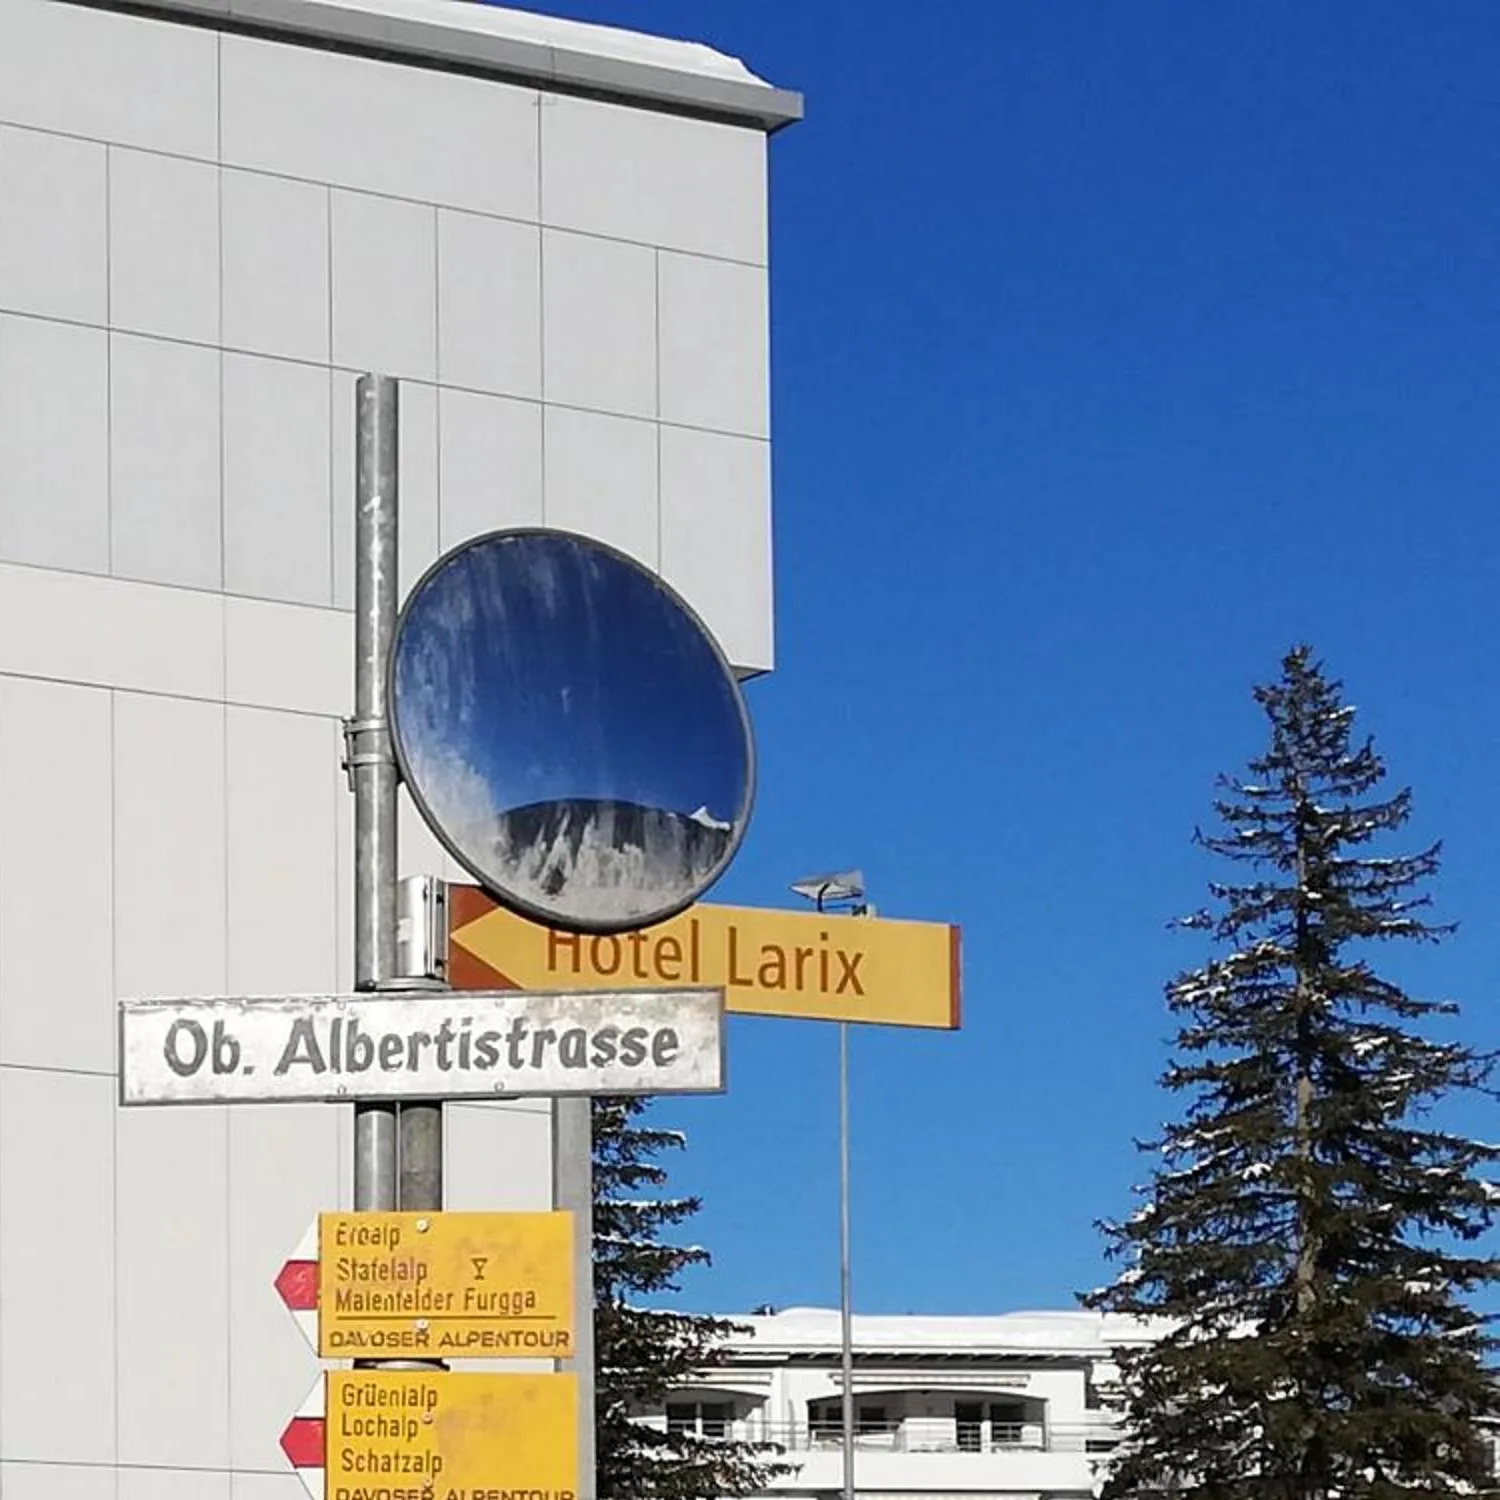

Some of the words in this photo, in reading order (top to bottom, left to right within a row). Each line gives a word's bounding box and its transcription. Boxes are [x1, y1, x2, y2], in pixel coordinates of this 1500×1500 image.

[547, 923, 702, 984] Hotel
[726, 924, 866, 996] Larix
[163, 1020, 254, 1077] Ob.
[274, 1017, 679, 1075] Albertistrasse
[336, 1257, 428, 1286] Stafelalp
[463, 1288, 536, 1315] Furgga
[329, 1330, 430, 1348] DAVOSER
[438, 1330, 571, 1348] ALPENTOUR
[341, 1412, 419, 1442] Lochalp
[341, 1448, 443, 1479] Schatzalp
